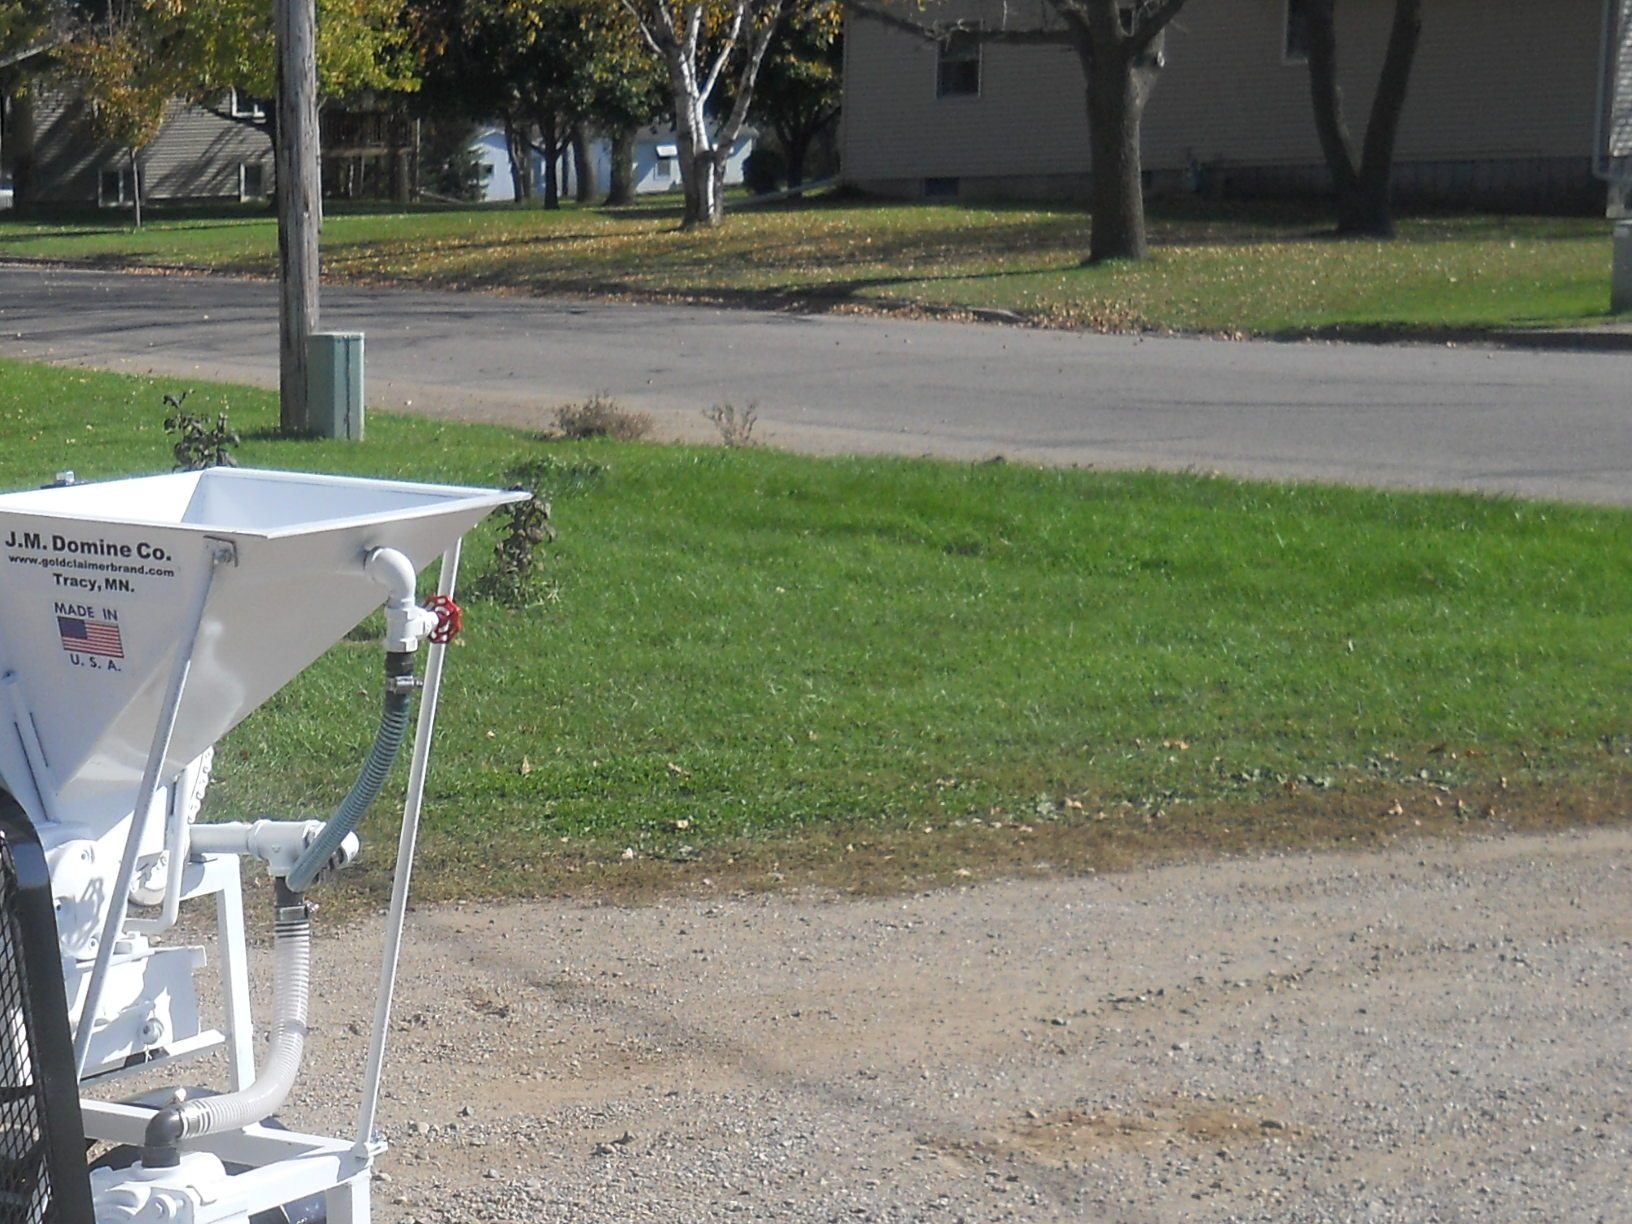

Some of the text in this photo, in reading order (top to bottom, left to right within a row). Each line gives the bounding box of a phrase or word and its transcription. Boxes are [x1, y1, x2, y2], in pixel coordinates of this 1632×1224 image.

[5, 531, 172, 561] J.M. Domine Co.
[8, 555, 175, 577] www.goldclaimerbrand.com
[52, 572, 135, 593] Tracy, MN.
[54, 602, 118, 621] MADE IN
